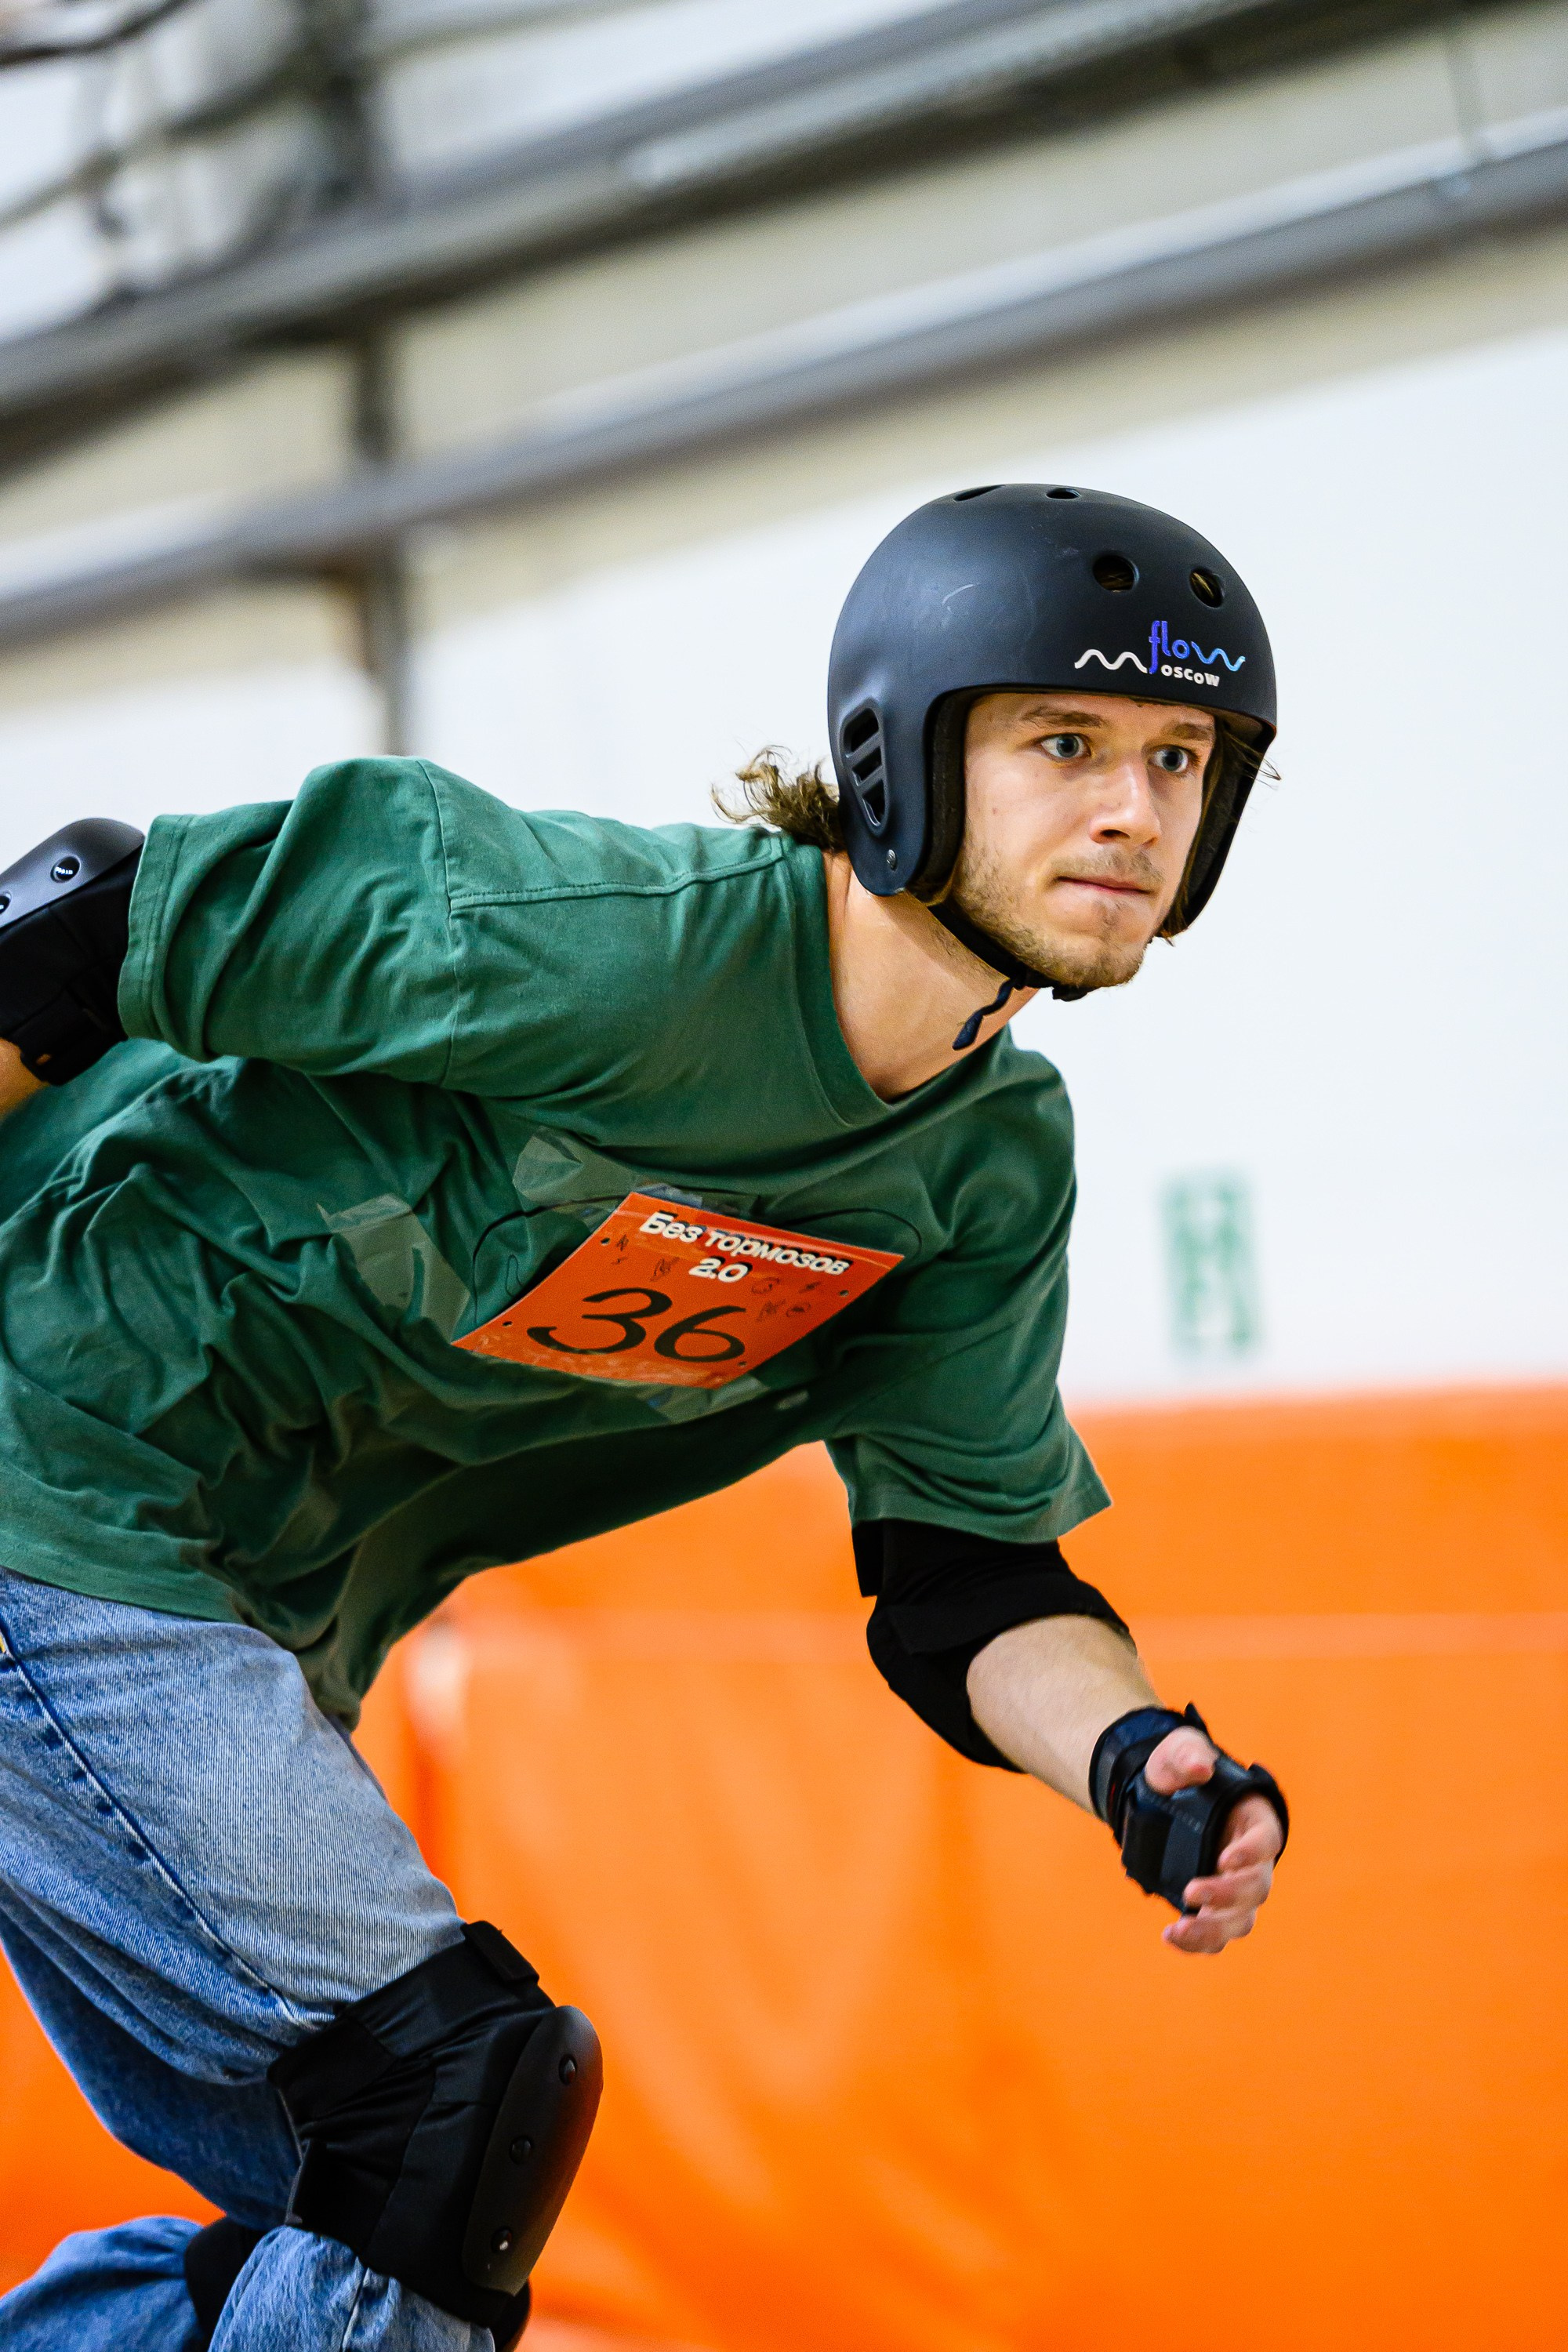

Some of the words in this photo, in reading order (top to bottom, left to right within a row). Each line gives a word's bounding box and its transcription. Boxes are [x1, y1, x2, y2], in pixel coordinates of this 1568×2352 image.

[1148, 619, 1247, 675] flow
[639, 1210, 704, 1243] Без
[704, 1229, 851, 1276] тормозов
[688, 1257, 750, 1283] 2.0
[526, 1287, 747, 1363] 36
